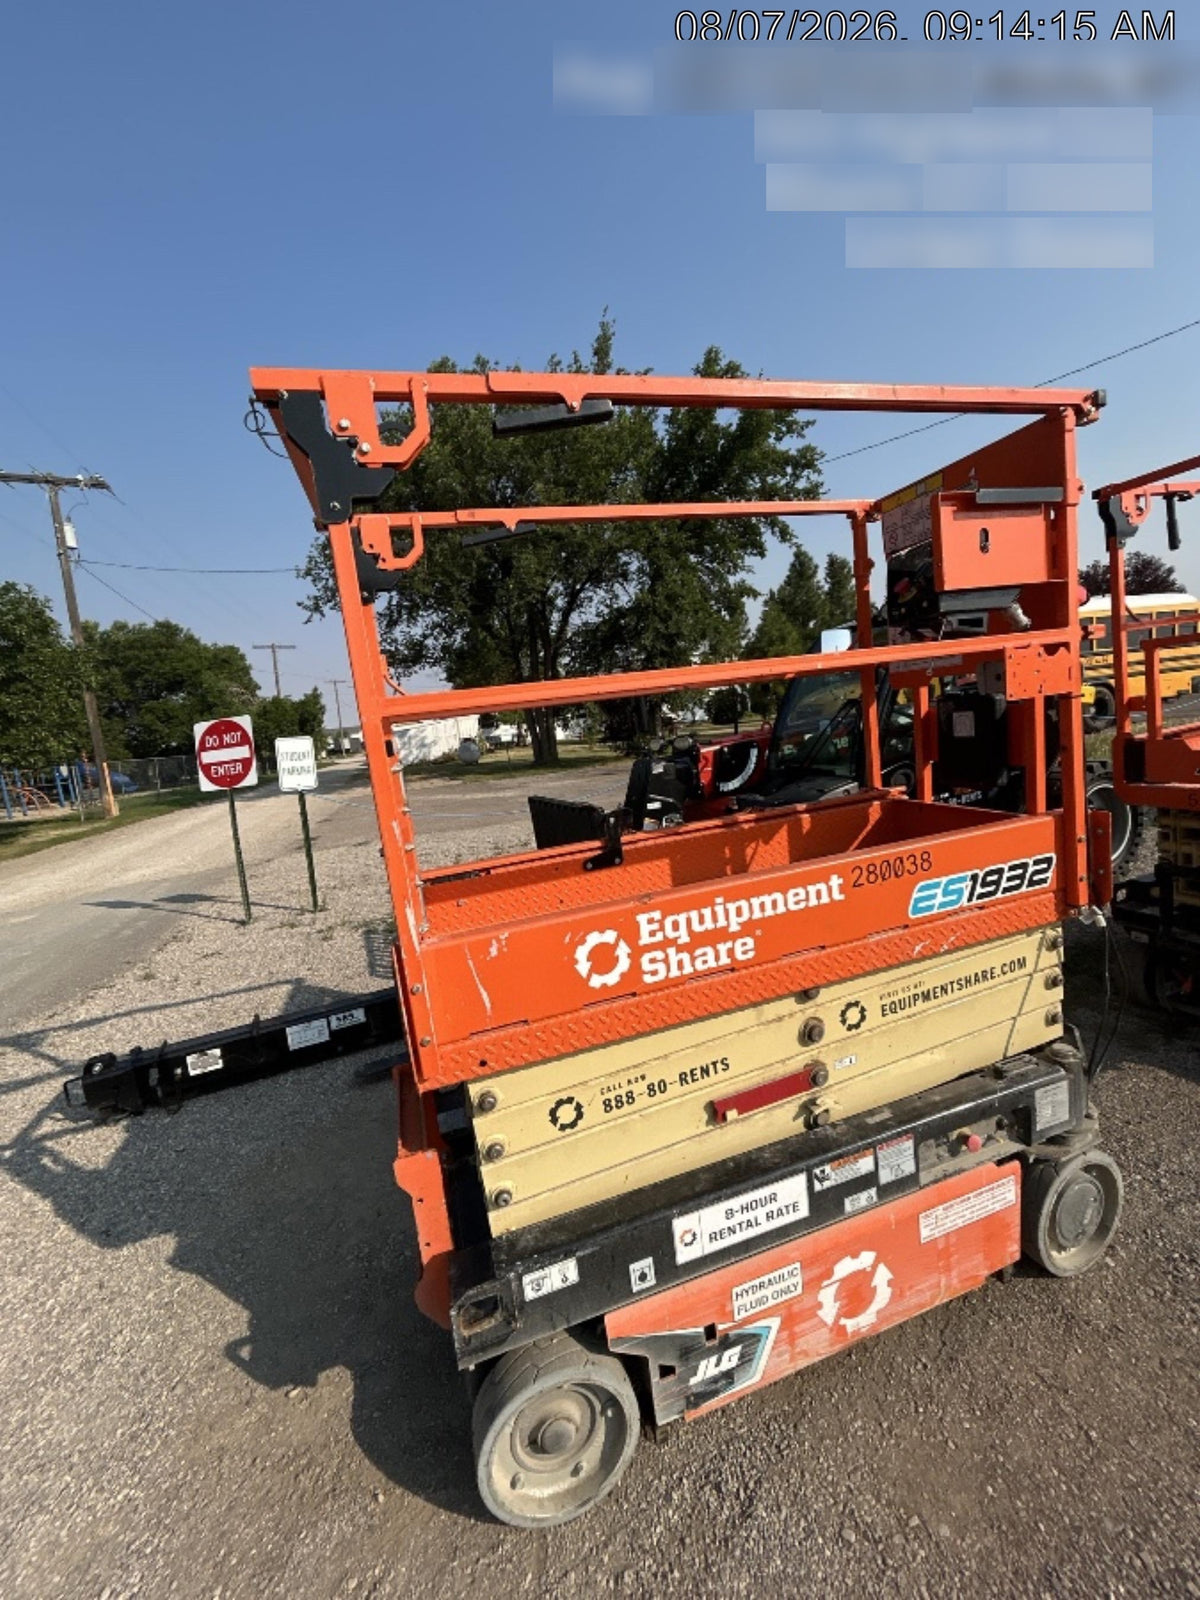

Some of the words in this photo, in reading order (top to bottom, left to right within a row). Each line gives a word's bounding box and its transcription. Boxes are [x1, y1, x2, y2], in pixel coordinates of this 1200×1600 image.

[205, 735, 218, 748] DO
[223, 732, 241, 745] NOT
[211, 763, 243, 777] ENTER
[851, 851, 933, 888] 280038
[909, 853, 1056, 918] ES1932
[636, 874, 845, 946] Equipment
[640, 936, 756, 984] Share
[881, 956, 1027, 1018] EQUIPMENTSHARE.COM
[600, 1082, 623, 1096] CALL
[602, 1057, 730, 1114] 888-80-RENTS
[708, 1216, 762, 1244] RENTAL
[765, 1201, 801, 1222] RATE
[724, 1192, 778, 1220] 8-HOUR
[735, 1267, 799, 1302] HYDRAULIC
[737, 1295, 769, 1316] FLUID
[771, 1281, 799, 1300] ONLY
[688, 1344, 743, 1386] JLG
